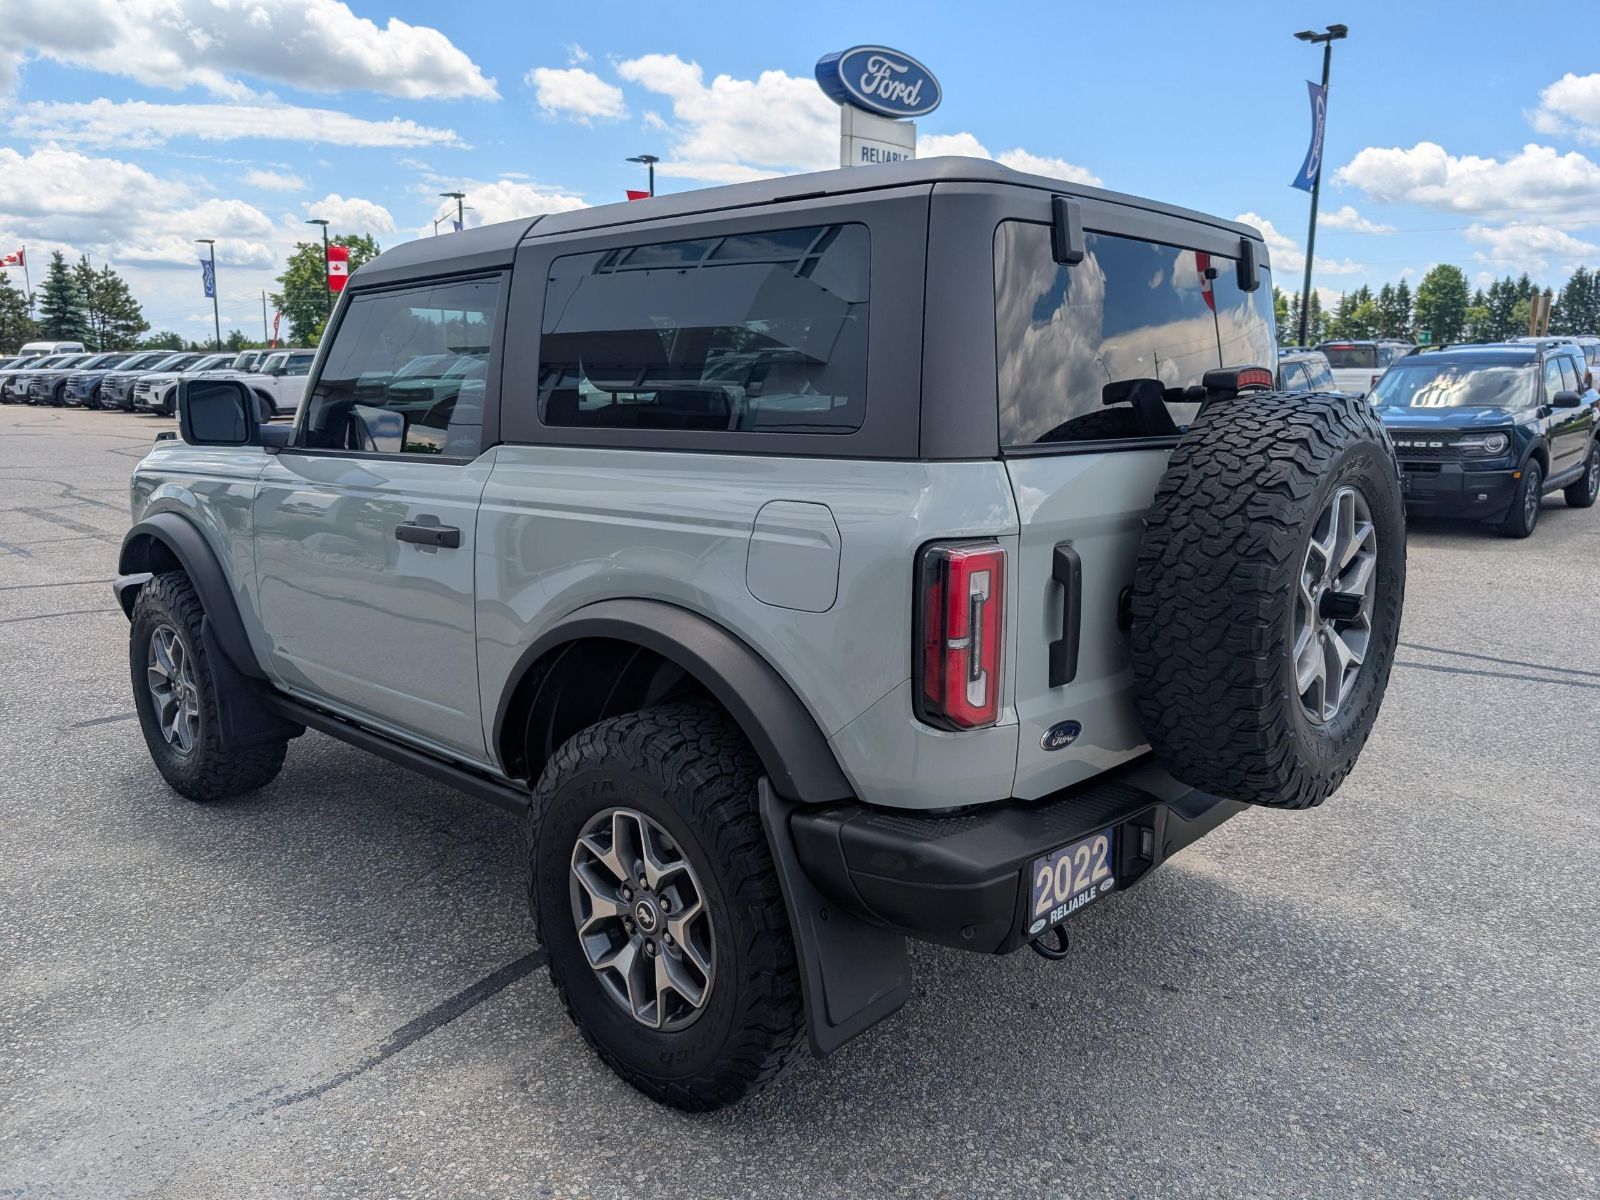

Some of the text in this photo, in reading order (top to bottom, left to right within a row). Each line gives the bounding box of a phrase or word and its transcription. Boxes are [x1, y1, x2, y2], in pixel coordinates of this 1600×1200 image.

[860, 55, 923, 107] Ford
[1036, 835, 1109, 916] 2022
[1050, 886, 1097, 925] RELIABLE
